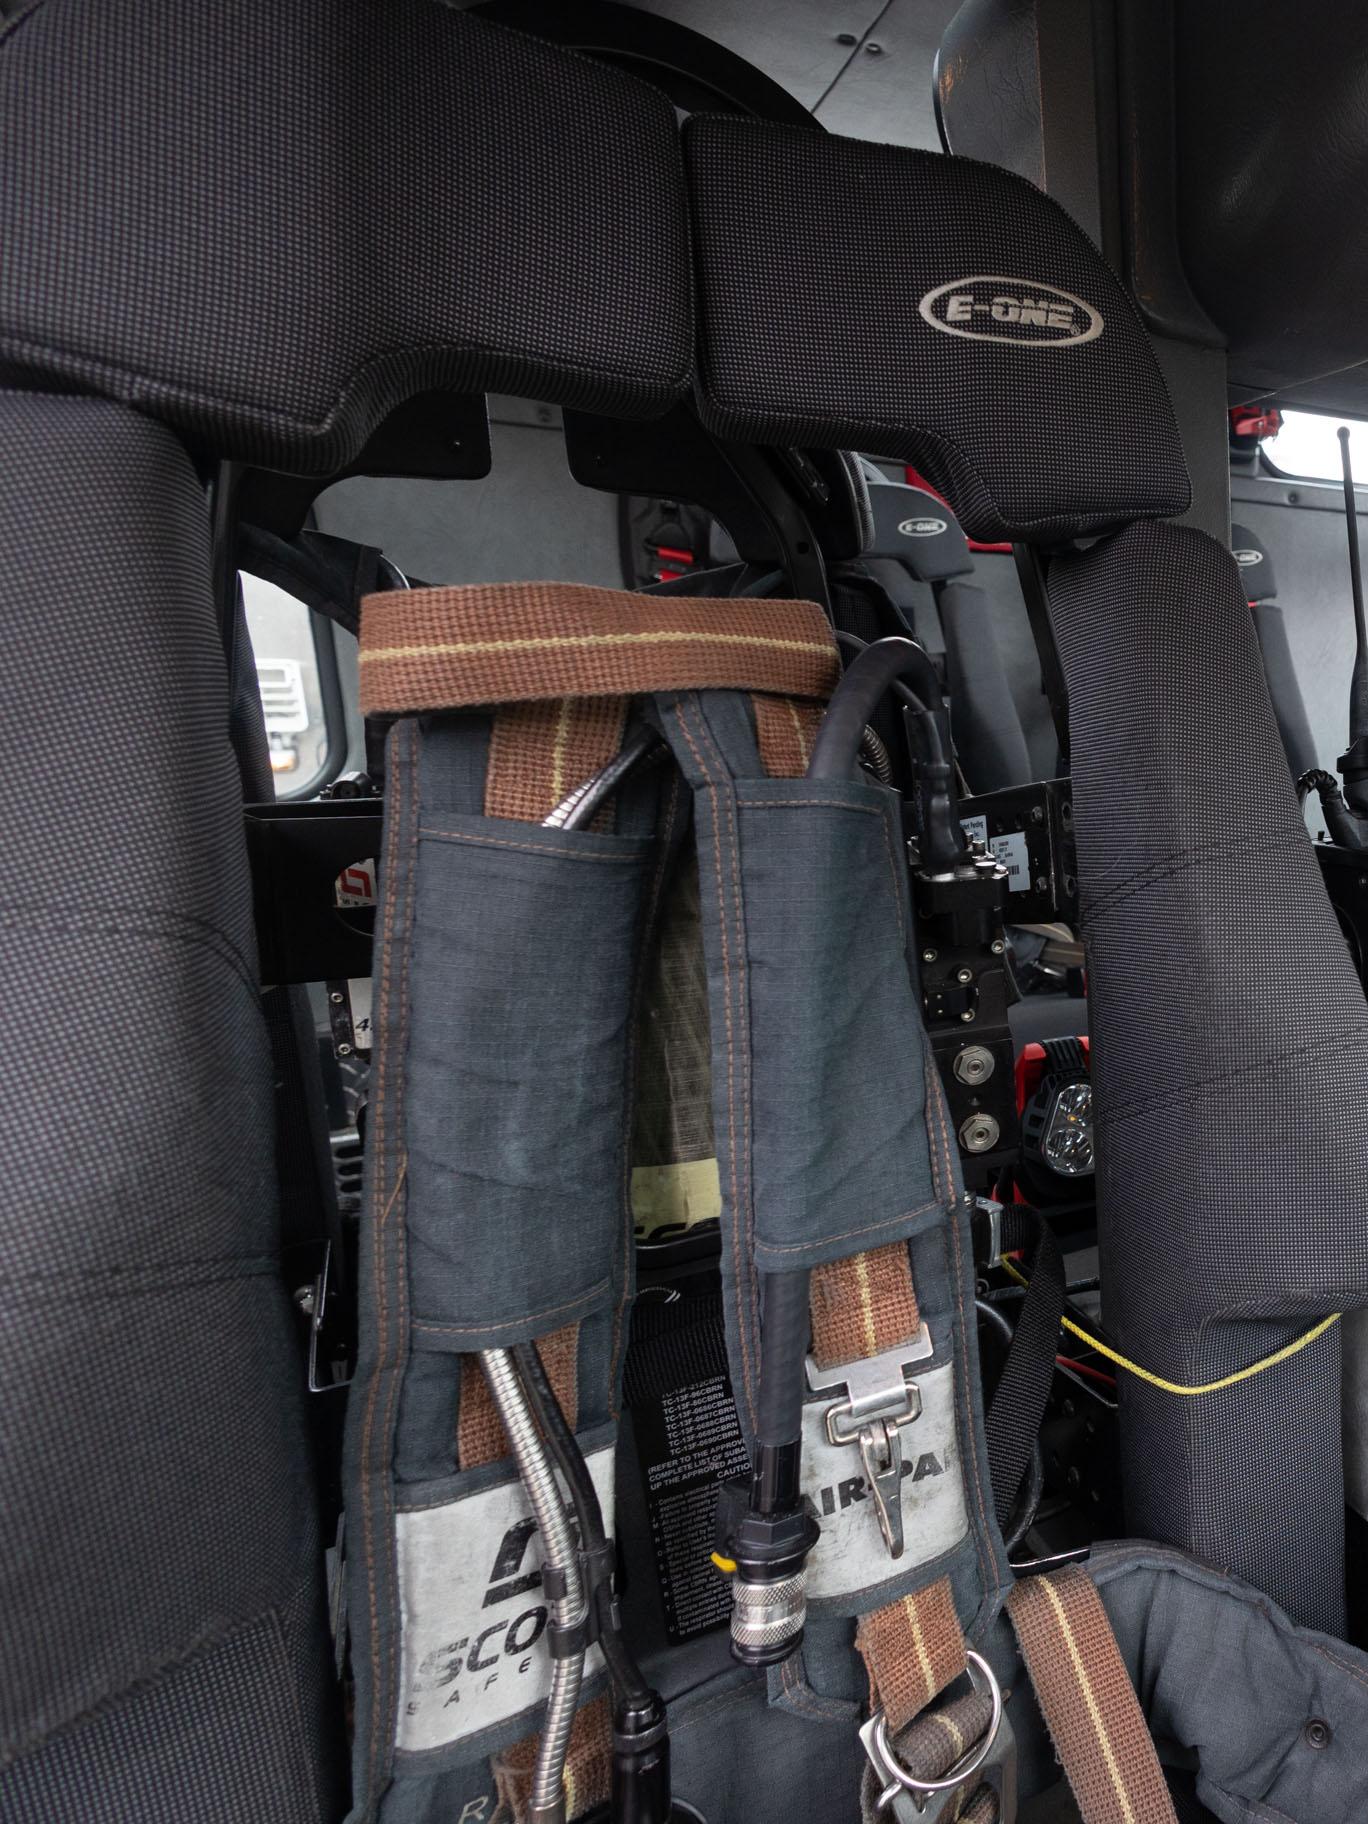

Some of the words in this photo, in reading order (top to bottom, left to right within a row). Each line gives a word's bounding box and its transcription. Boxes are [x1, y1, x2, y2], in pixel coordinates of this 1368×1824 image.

[946, 294, 1075, 330] E-ONE
[649, 1465, 693, 1482] COMPLETE
[694, 1457, 711, 1468] LIST
[712, 1453, 723, 1462] OF
[724, 1446, 746, 1459] SUBA
[679, 1456, 692, 1464] TO
[693, 1450, 709, 1460] THE
[710, 1438, 745, 1454] APPROV
[650, 1482, 662, 1491] UP
[664, 1477, 680, 1486] THE
[681, 1460, 726, 1480] APPROVED
[727, 1454, 749, 1466] ASSE
[716, 1462, 752, 1479] CAUTIO
[800, 1449, 950, 1519] AIRPA
[419, 1605, 551, 1689] SCO
